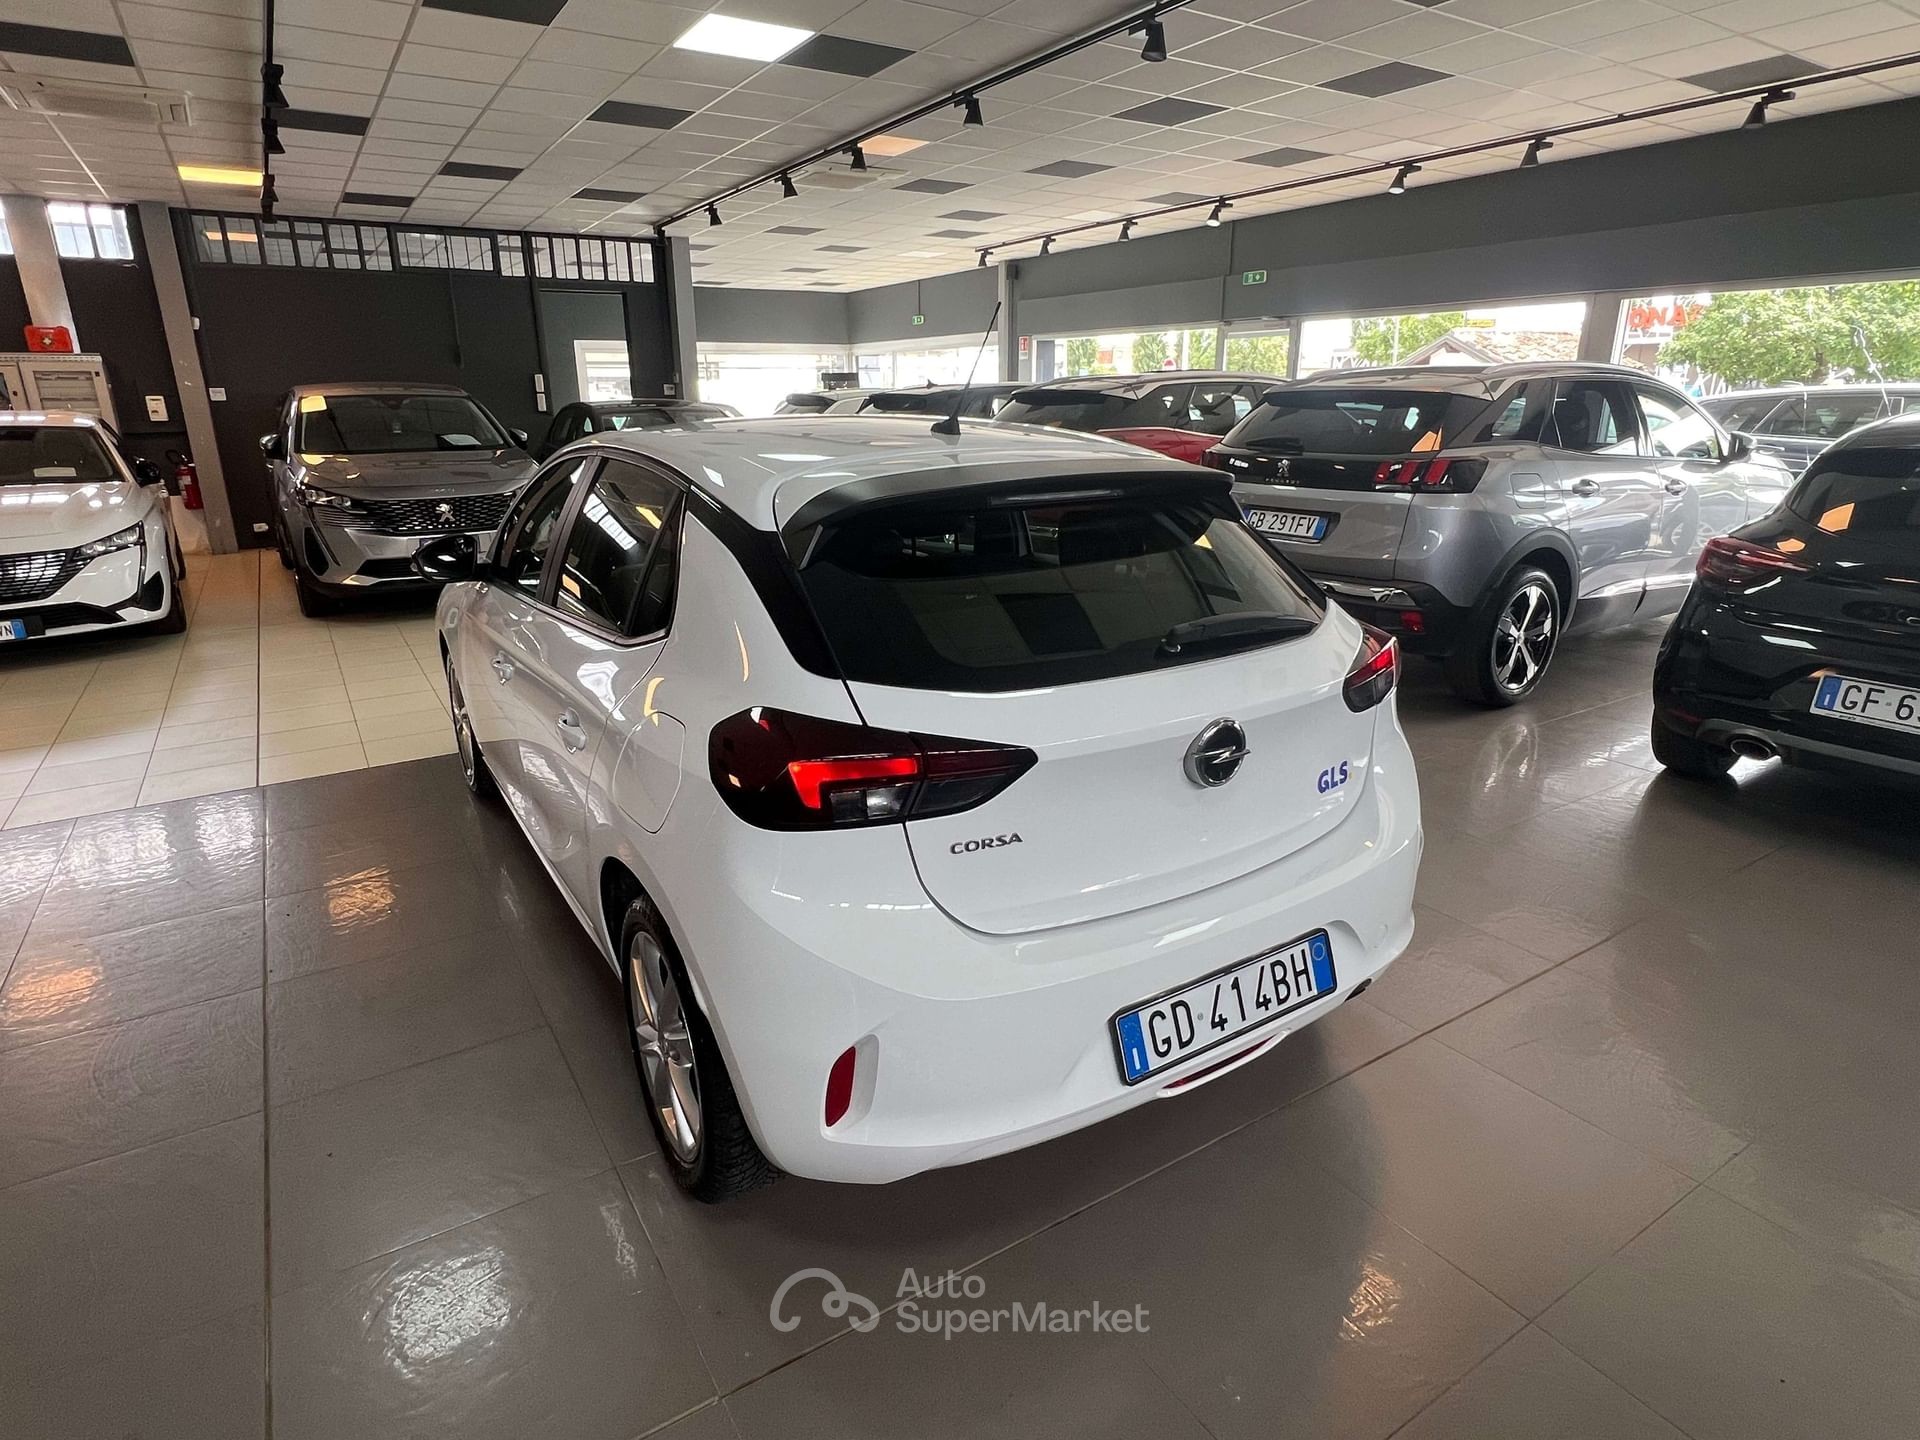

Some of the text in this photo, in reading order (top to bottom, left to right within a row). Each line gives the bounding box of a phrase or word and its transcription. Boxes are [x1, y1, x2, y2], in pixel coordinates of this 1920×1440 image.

[1268, 514, 1316, 534] 291FV
[1840, 684, 1886, 714] GF
[1895, 694, 1920, 722] 6
[1317, 760, 1348, 794] GLS
[949, 832, 1023, 855] CORSA
[1148, 999, 1195, 1058] GD
[1210, 948, 1313, 1032] 414BH
